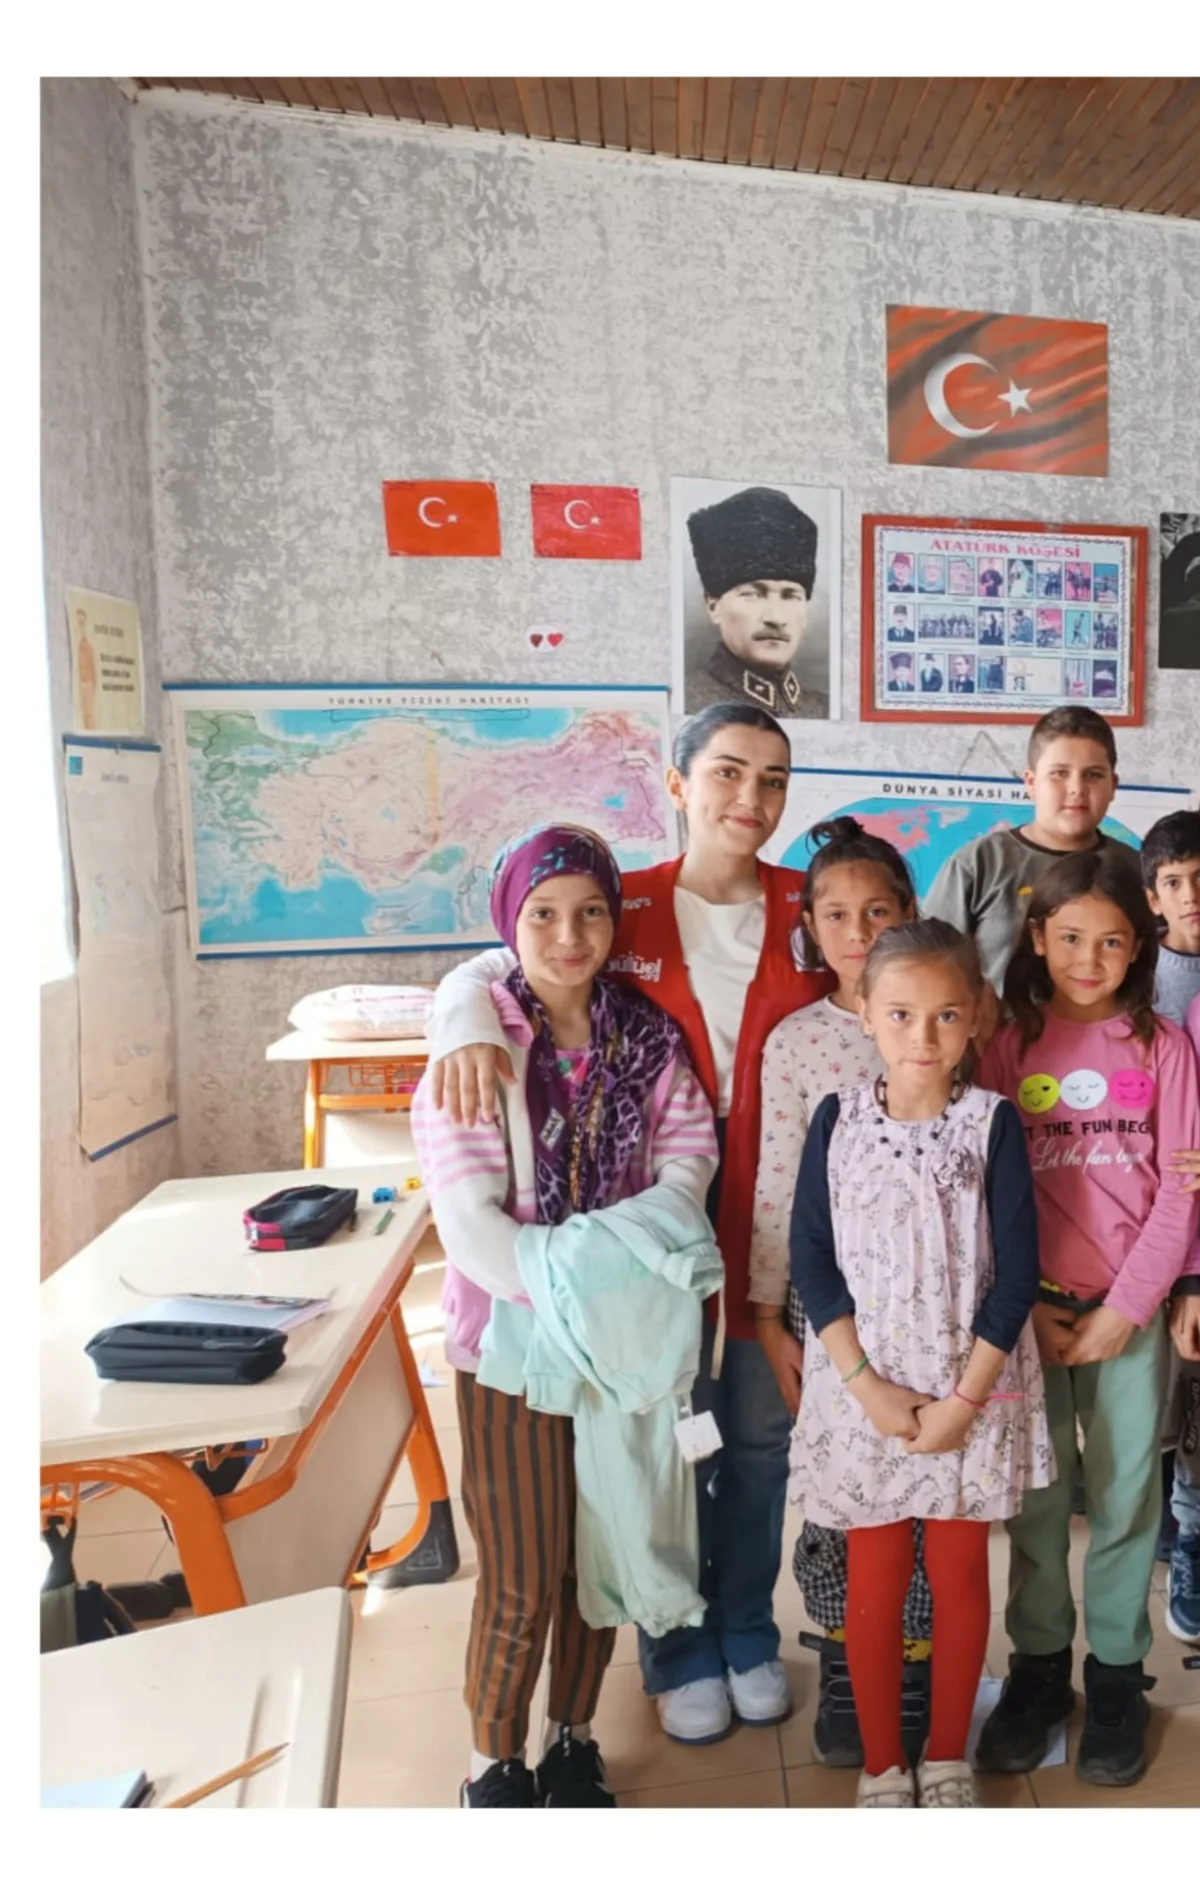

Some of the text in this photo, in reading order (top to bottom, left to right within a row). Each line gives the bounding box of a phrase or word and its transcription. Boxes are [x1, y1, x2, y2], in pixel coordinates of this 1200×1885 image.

[930, 539, 1010, 554] ATATÜRK
[328, 696, 392, 705] TÜRKİYE
[882, 783, 938, 796] DÜNYA
[1044, 1122, 1073, 1137] THE
[1081, 1119, 1113, 1135] FUN
[1061, 1141, 1082, 1166] the
[1082, 1140, 1113, 1175] fun
